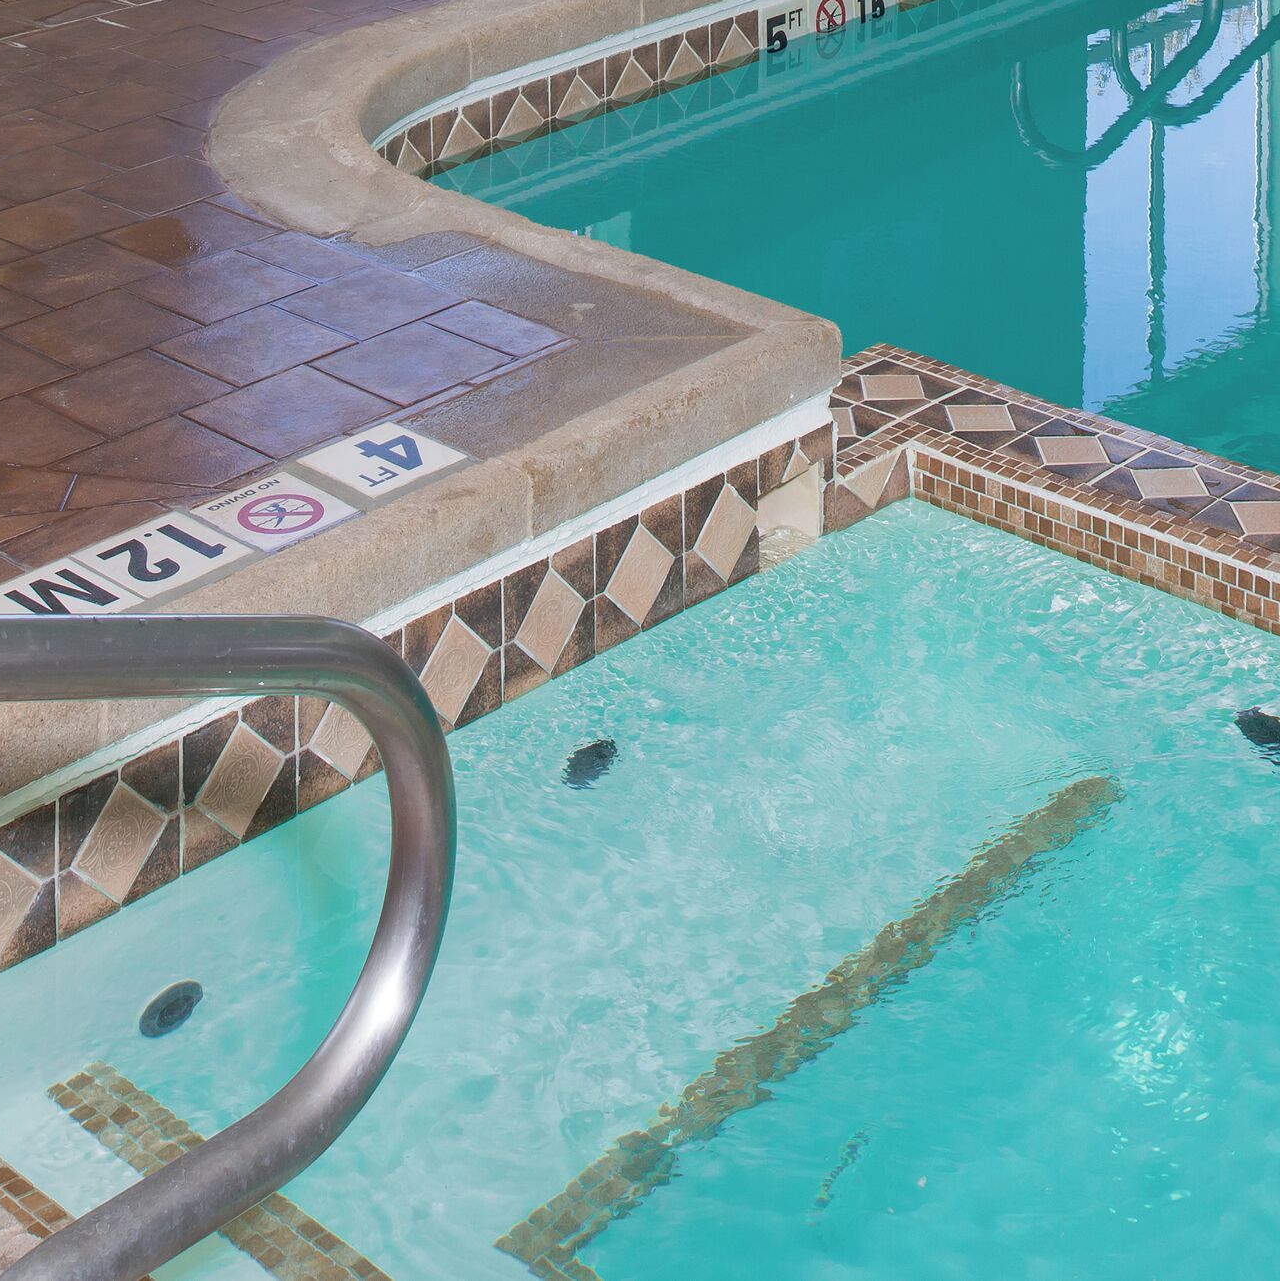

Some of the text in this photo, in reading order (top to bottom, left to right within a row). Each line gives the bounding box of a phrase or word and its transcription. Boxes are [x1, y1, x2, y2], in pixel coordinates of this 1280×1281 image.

[766, 13, 788, 54] 5
[788, 7, 803, 30] FT
[354, 433, 423, 488] 4 FT
[206, 478, 281, 513] NO DIVING
[3, 568, 120, 615] M
